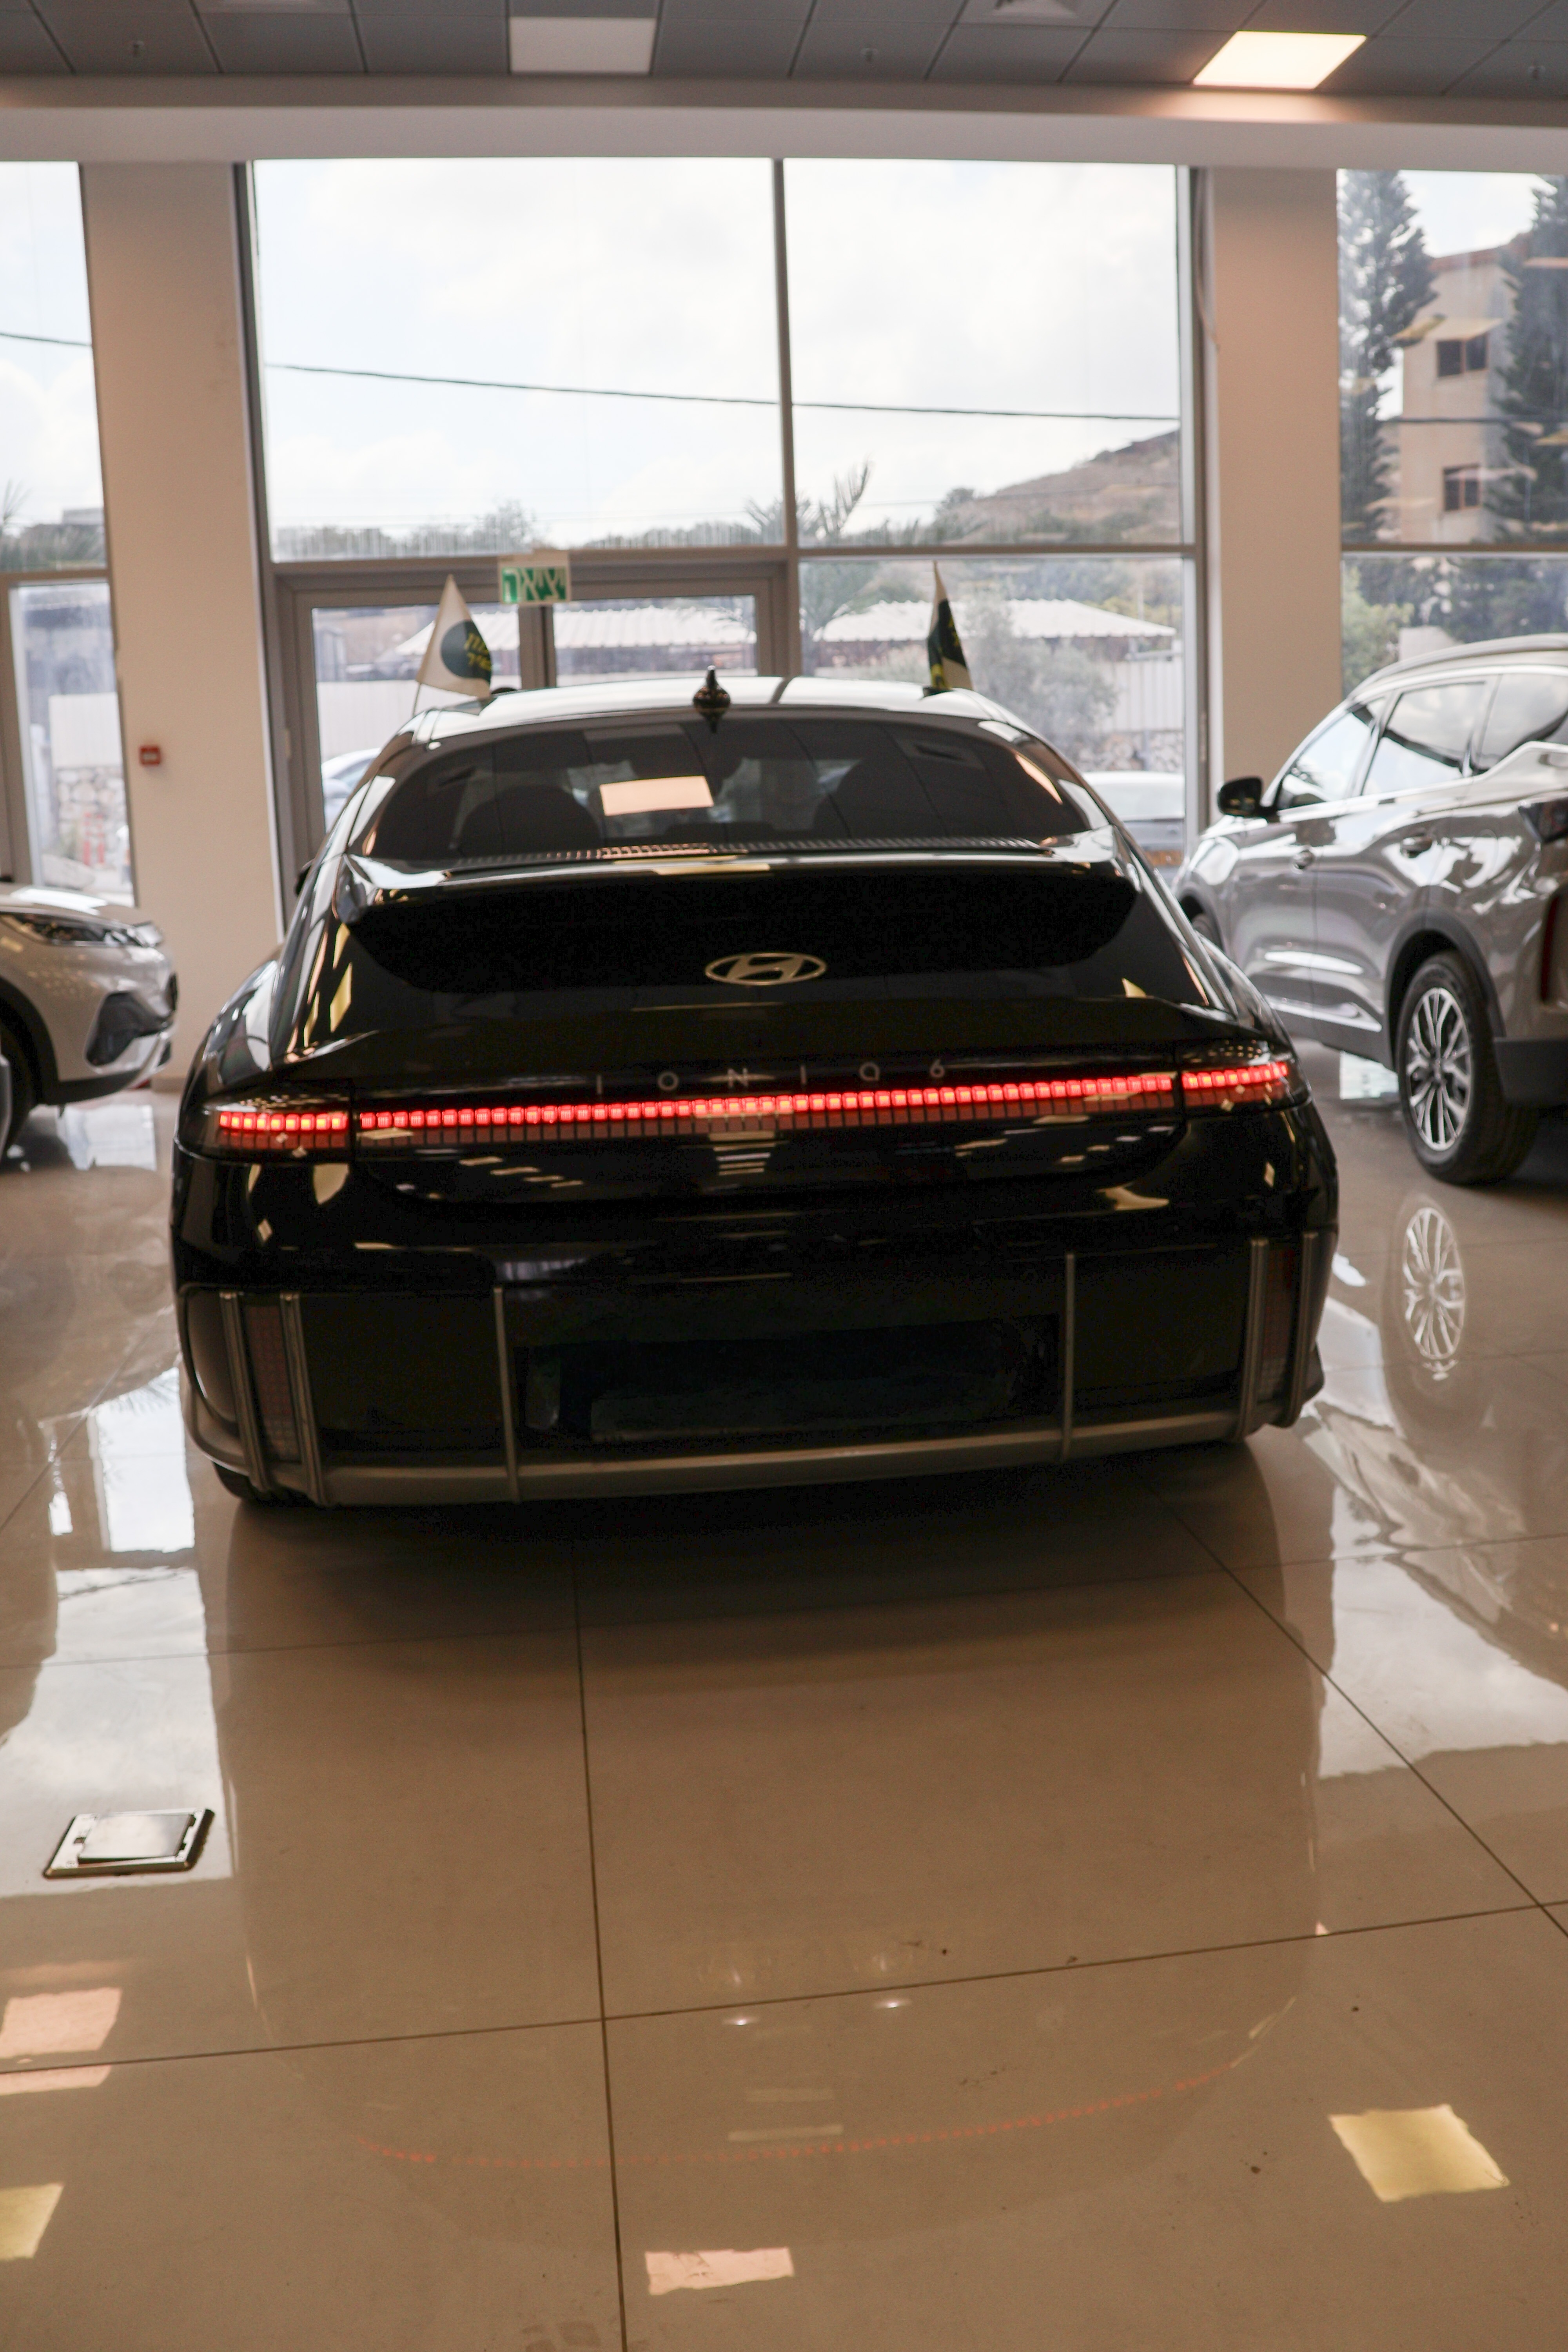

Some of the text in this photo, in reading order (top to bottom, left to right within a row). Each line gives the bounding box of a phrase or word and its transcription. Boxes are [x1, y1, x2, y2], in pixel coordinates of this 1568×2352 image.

[504, 568, 566, 603] יציאה
[596, 1059, 945, 1095] IONIQ 6
